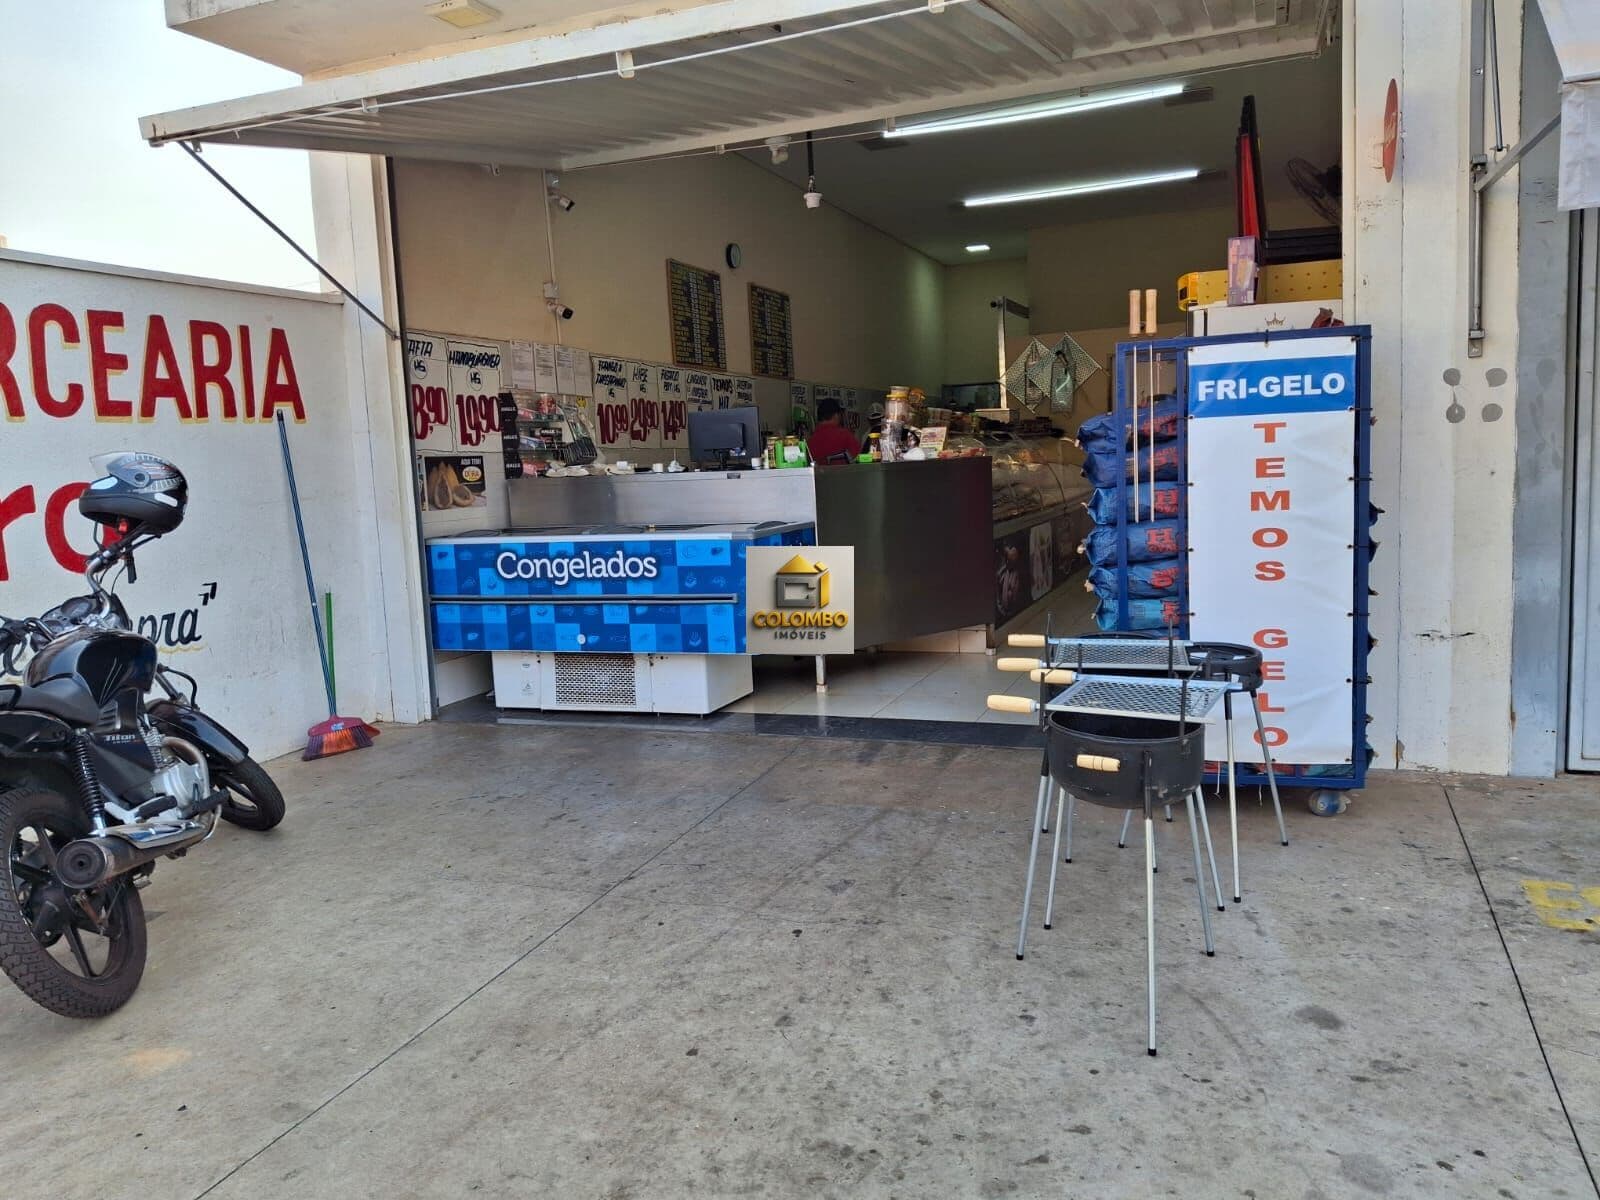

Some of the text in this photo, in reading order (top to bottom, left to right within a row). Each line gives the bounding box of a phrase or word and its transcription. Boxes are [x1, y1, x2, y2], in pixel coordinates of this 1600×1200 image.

[1198, 372, 1346, 402] FRI-GELO
[1250, 422, 1290, 581] TEMOS
[496, 550, 659, 586] Congelados
[128, 608, 202, 649] pra
